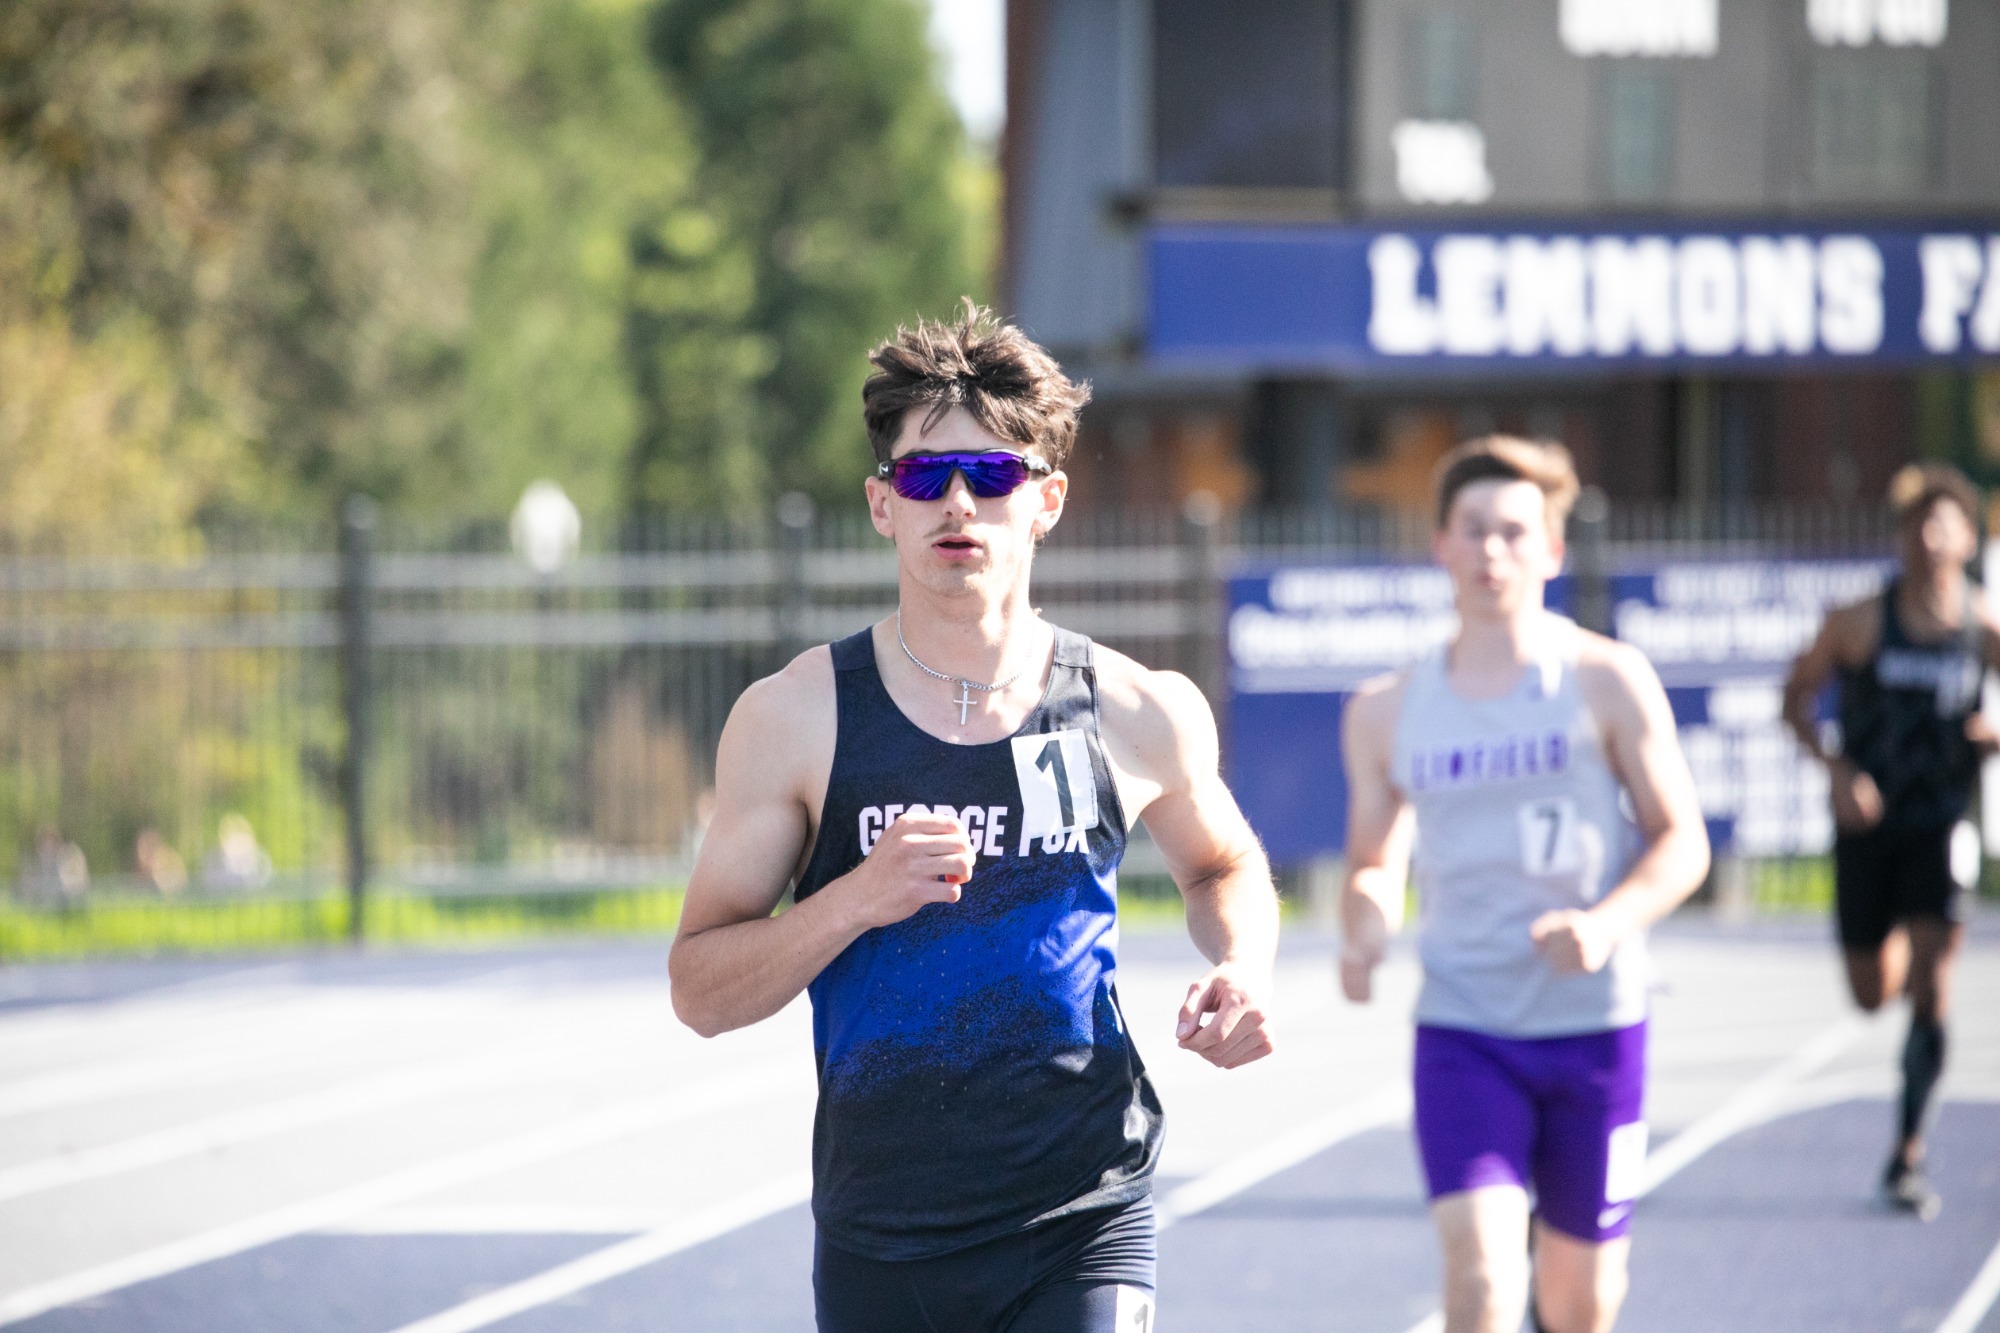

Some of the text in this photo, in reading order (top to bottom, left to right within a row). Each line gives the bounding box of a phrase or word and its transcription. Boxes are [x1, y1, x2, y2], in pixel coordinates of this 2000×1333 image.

[1370, 235, 1884, 354] LEMMONS
[1035, 739, 1075, 828] 1
[1535, 805, 1561, 863] 7
